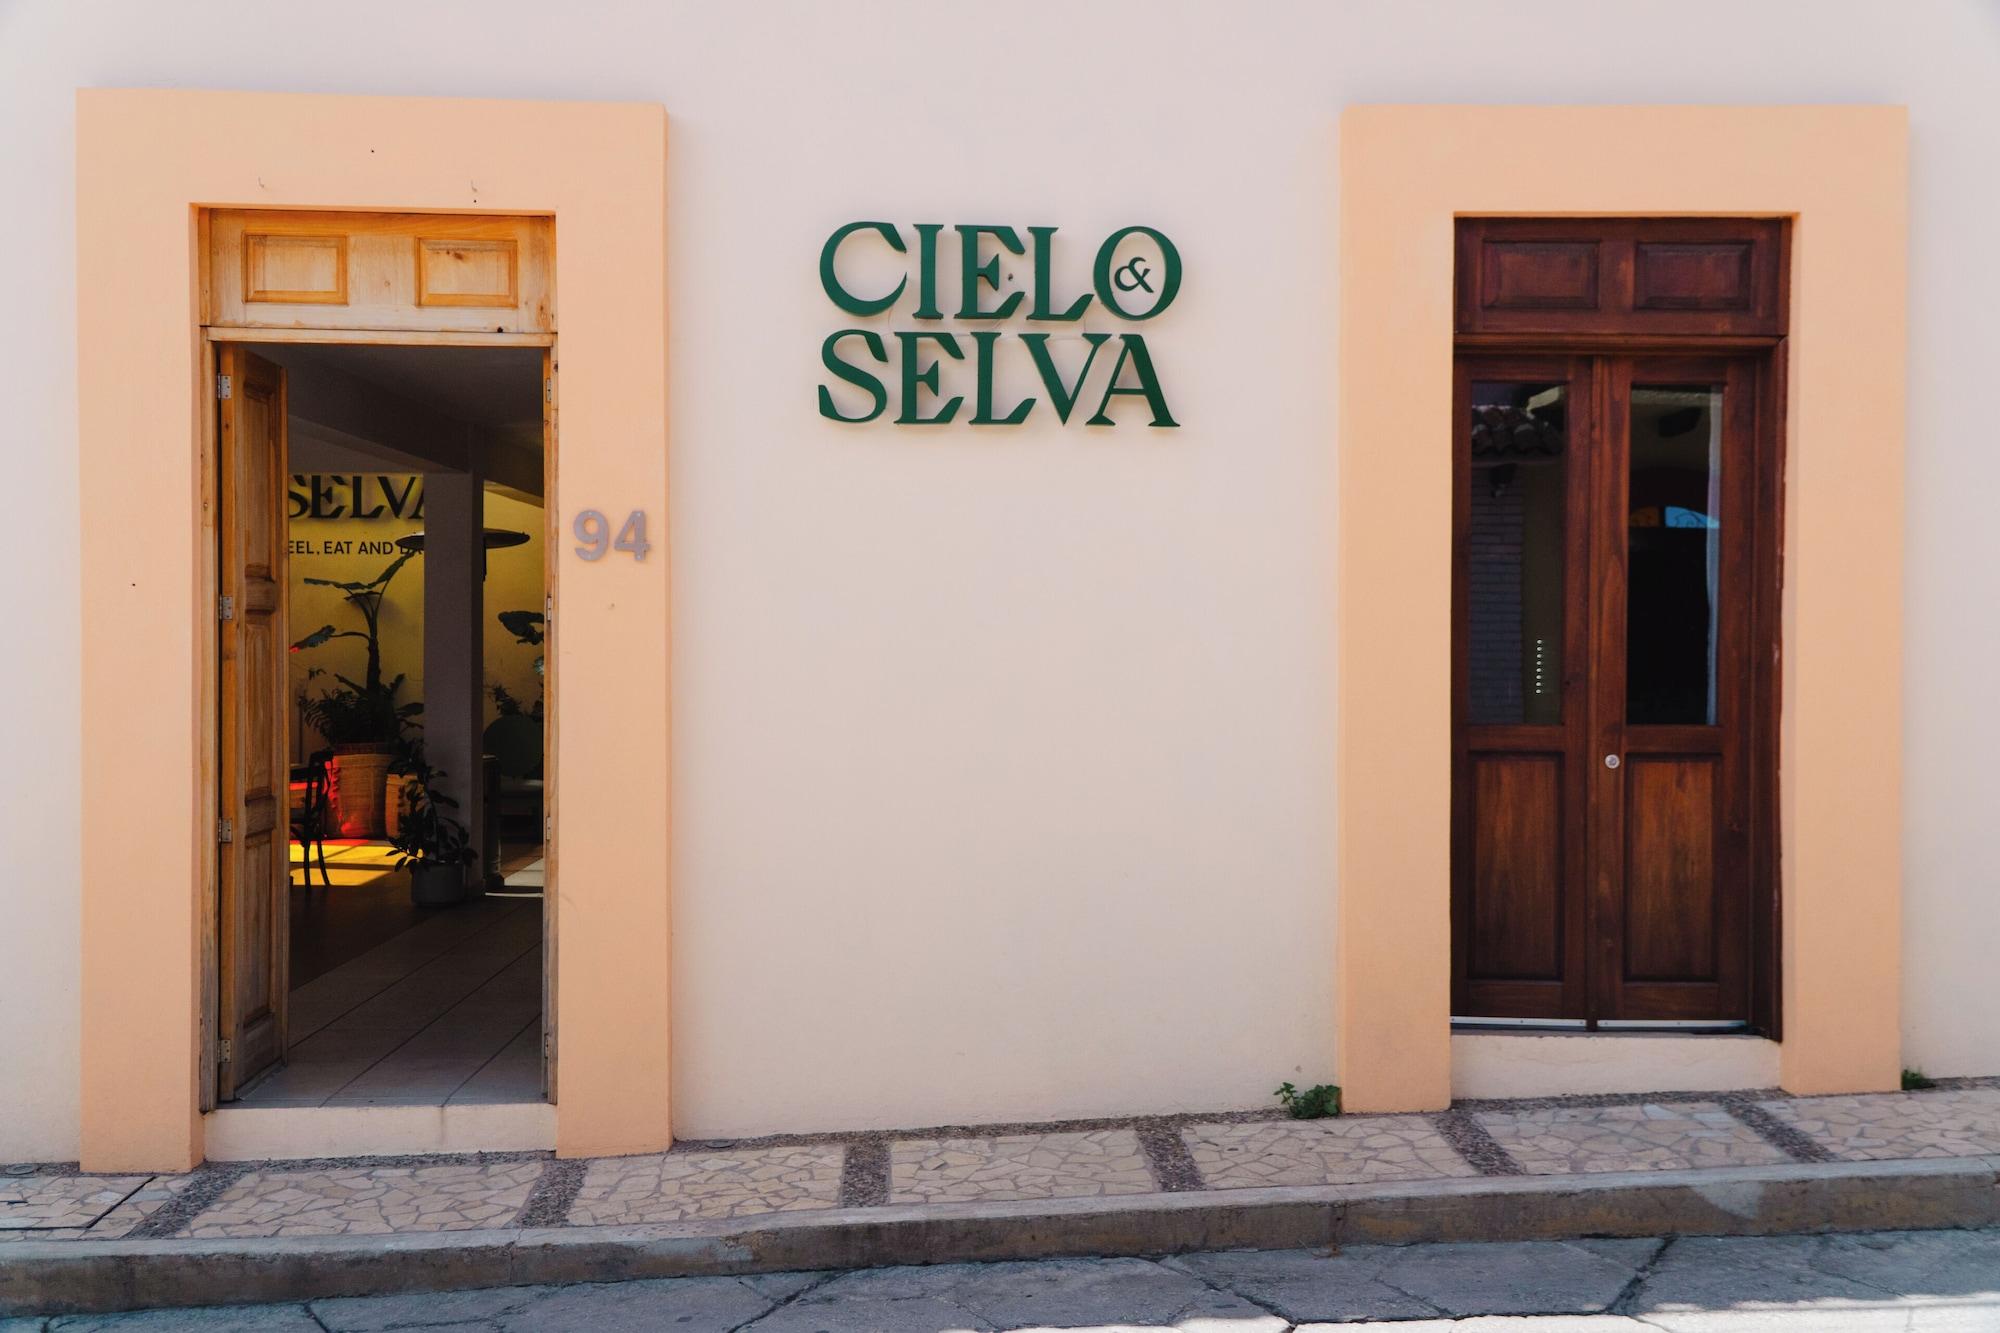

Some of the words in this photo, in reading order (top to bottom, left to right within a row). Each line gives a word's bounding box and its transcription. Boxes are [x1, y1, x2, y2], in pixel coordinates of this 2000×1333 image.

[819, 221, 1183, 322] CIELO
[1114, 256, 1154, 294] &
[817, 328, 1181, 428] SELVA
[323, 540, 353, 555] EAT
[357, 541, 394, 555] AND
[573, 509, 651, 562] 94
